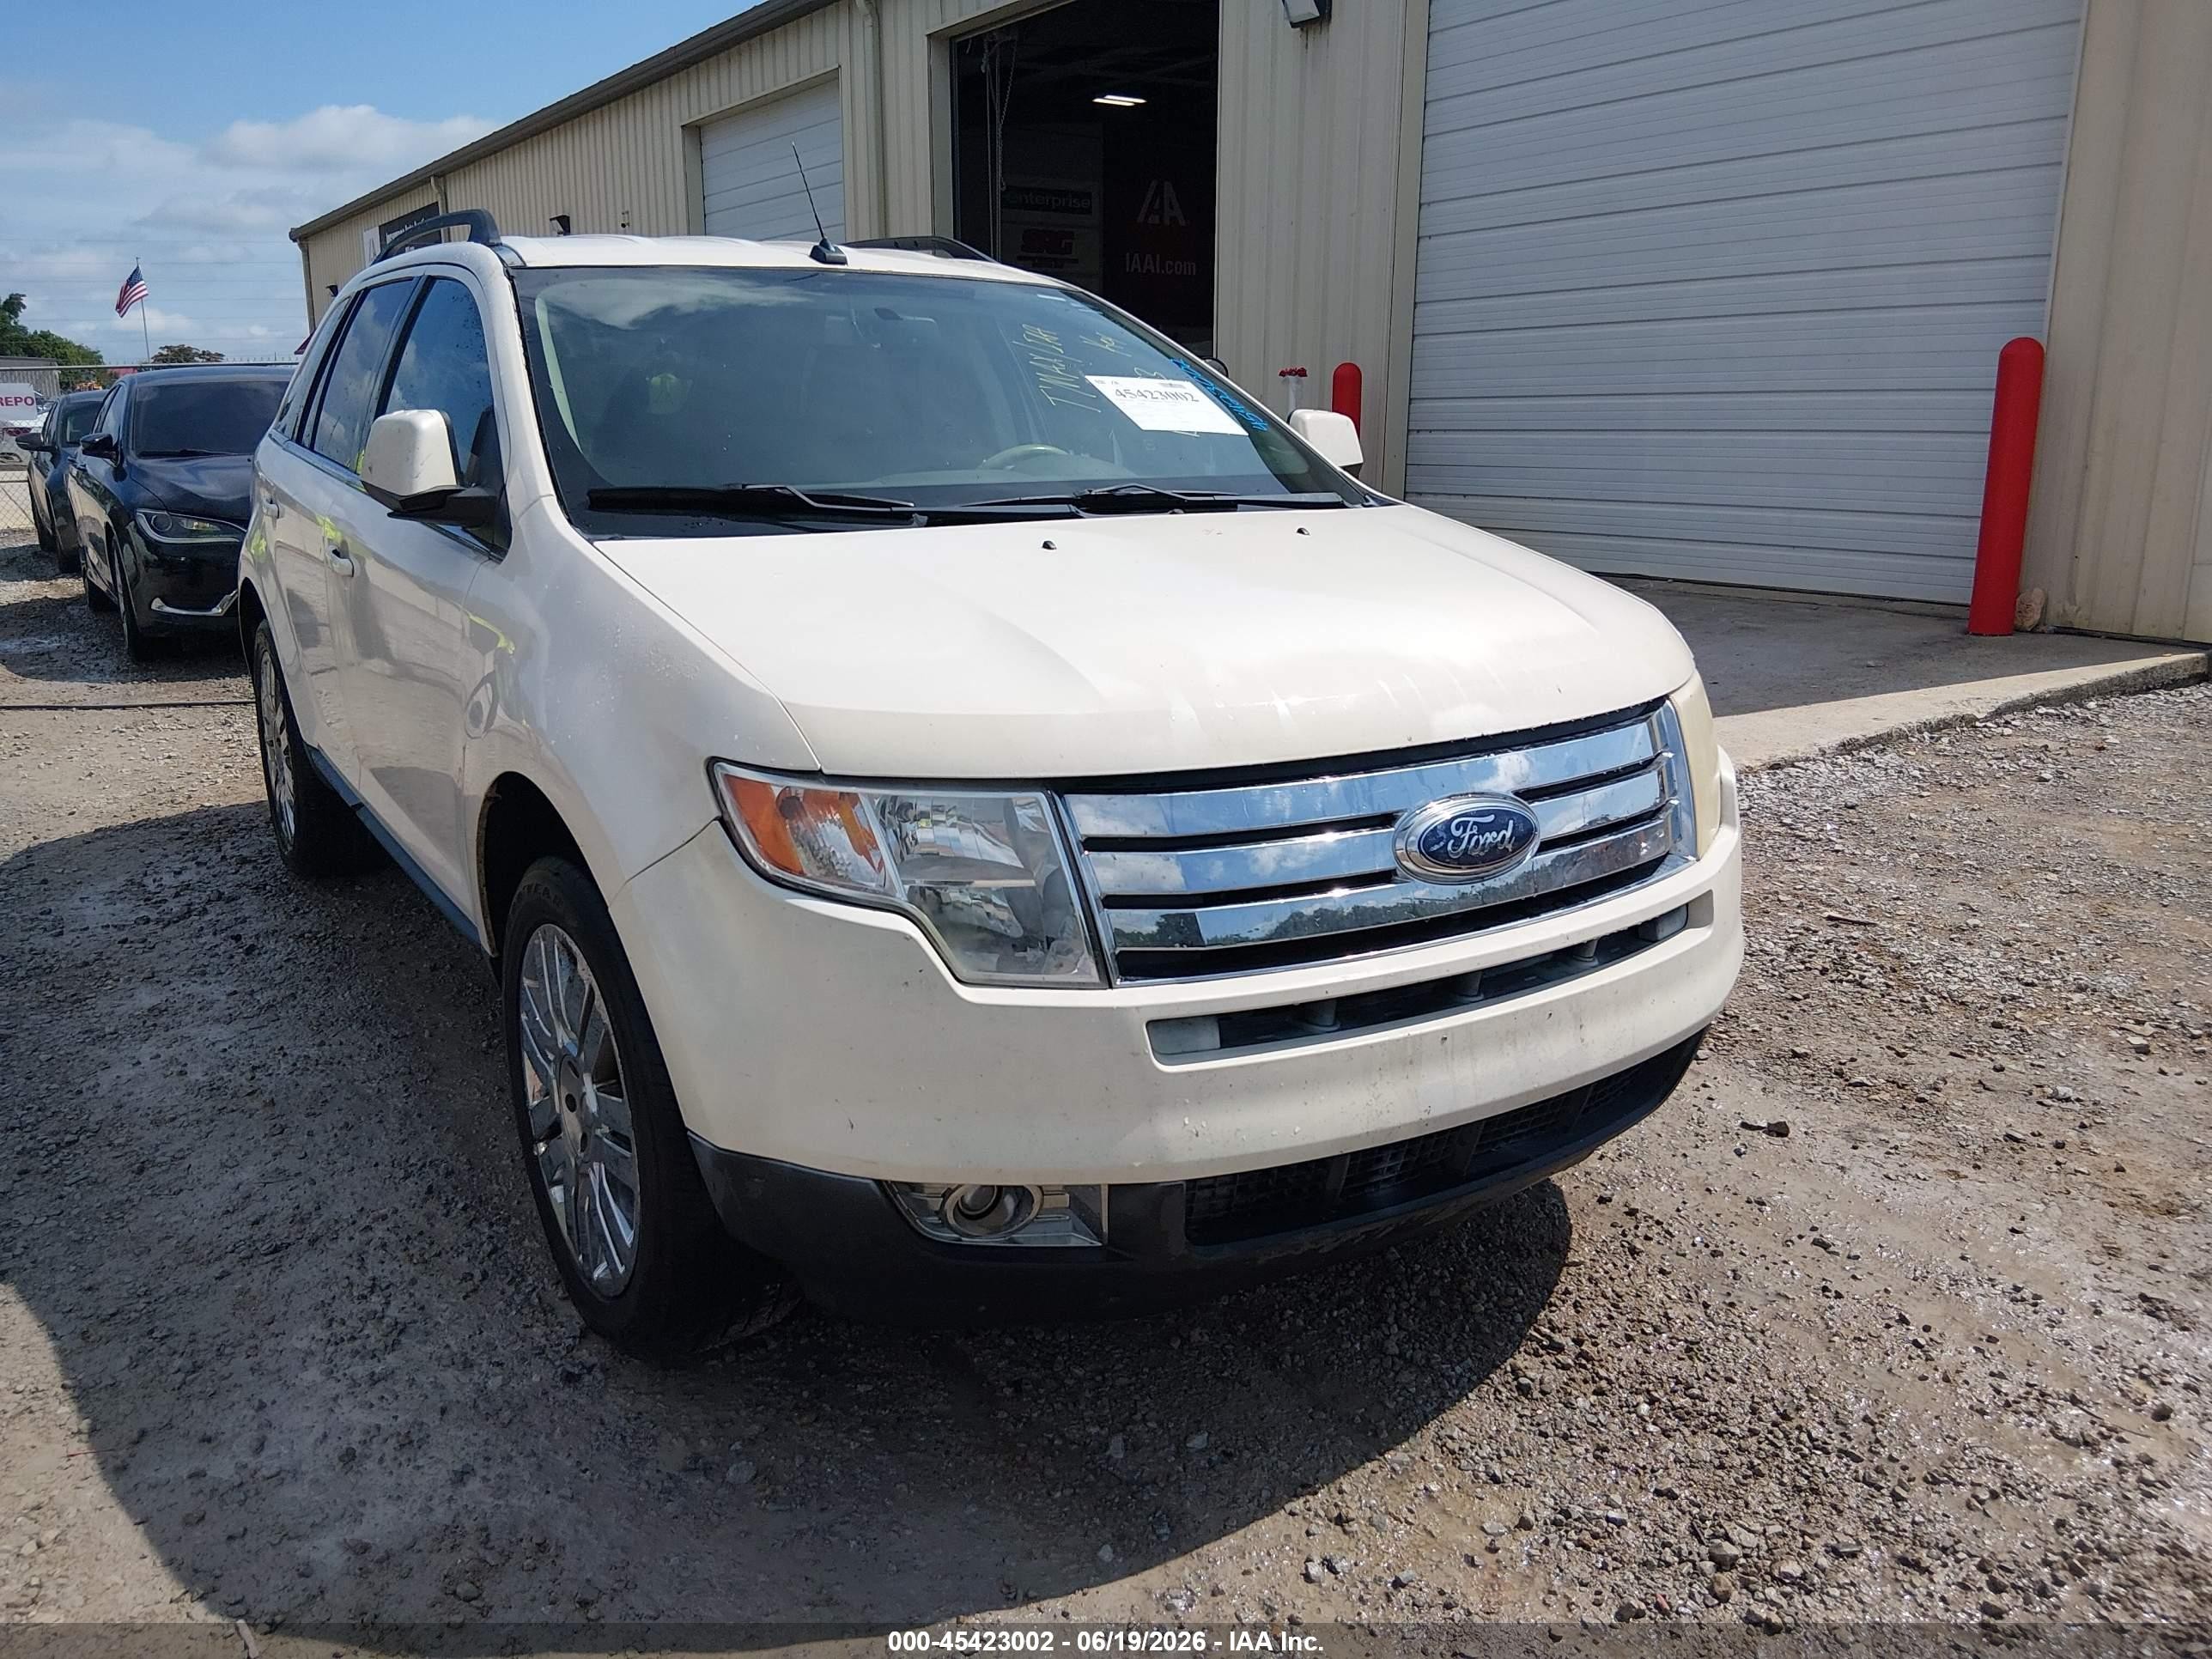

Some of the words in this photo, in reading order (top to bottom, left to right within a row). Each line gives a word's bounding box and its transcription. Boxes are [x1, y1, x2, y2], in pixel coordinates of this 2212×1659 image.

[1126, 252, 1196, 276] IAAI.com
[1115, 388, 1200, 403] 45423002
[1446, 813, 1516, 860] Ford
